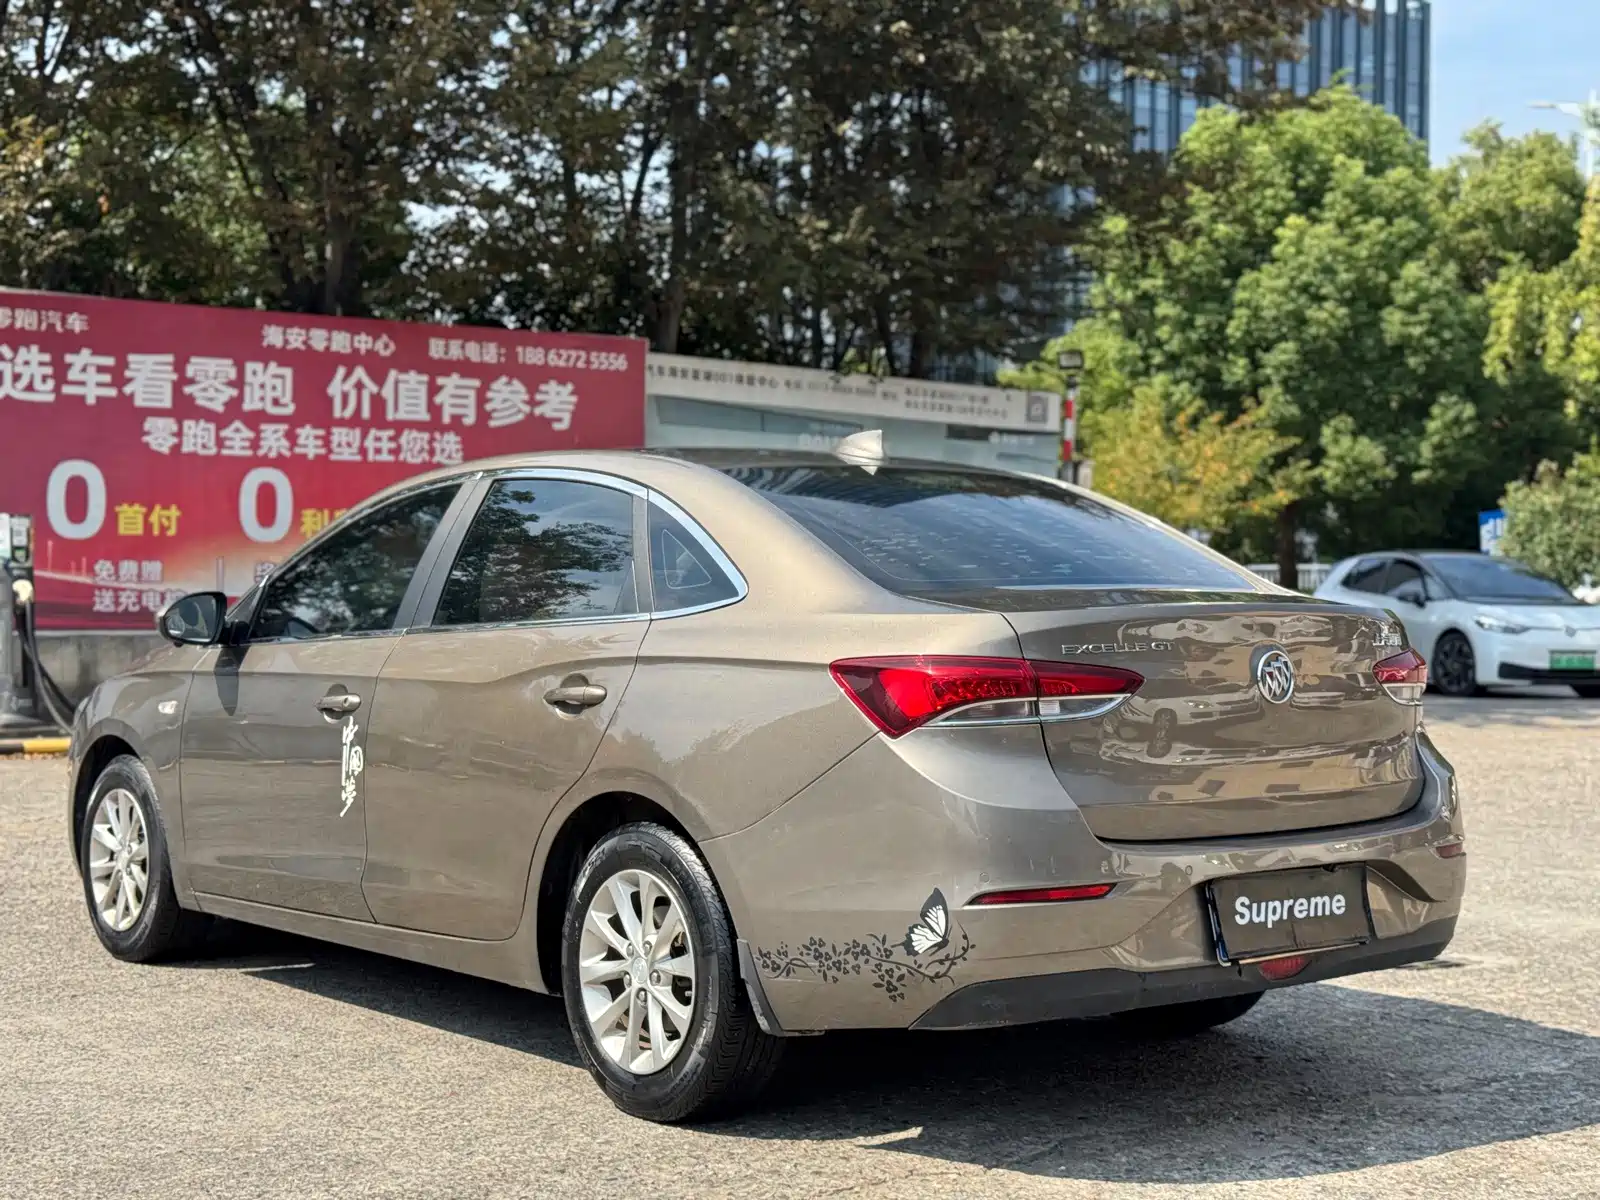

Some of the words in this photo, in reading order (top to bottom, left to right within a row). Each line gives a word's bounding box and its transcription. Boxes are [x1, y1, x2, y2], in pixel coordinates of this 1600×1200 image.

[262, 324, 396, 357] 海安零跑中心
[515, 346, 545, 365] 188
[547, 349, 587, 369] 6272
[589, 352, 628, 371] 5556
[0, 343, 296, 416] 选车看零跑
[327, 365, 578, 431] 价值有参考
[141, 416, 464, 464] 零跑全系车型任您选
[46, 459, 107, 540] 0
[115, 504, 181, 536] 首付
[238, 466, 294, 543] 0
[300, 508, 346, 540] 利
[93, 559, 163, 584] 免费赠
[1061, 642, 1149, 655] EXCELLE
[1151, 641, 1176, 651] GT
[1234, 893, 1346, 928] Supreme
